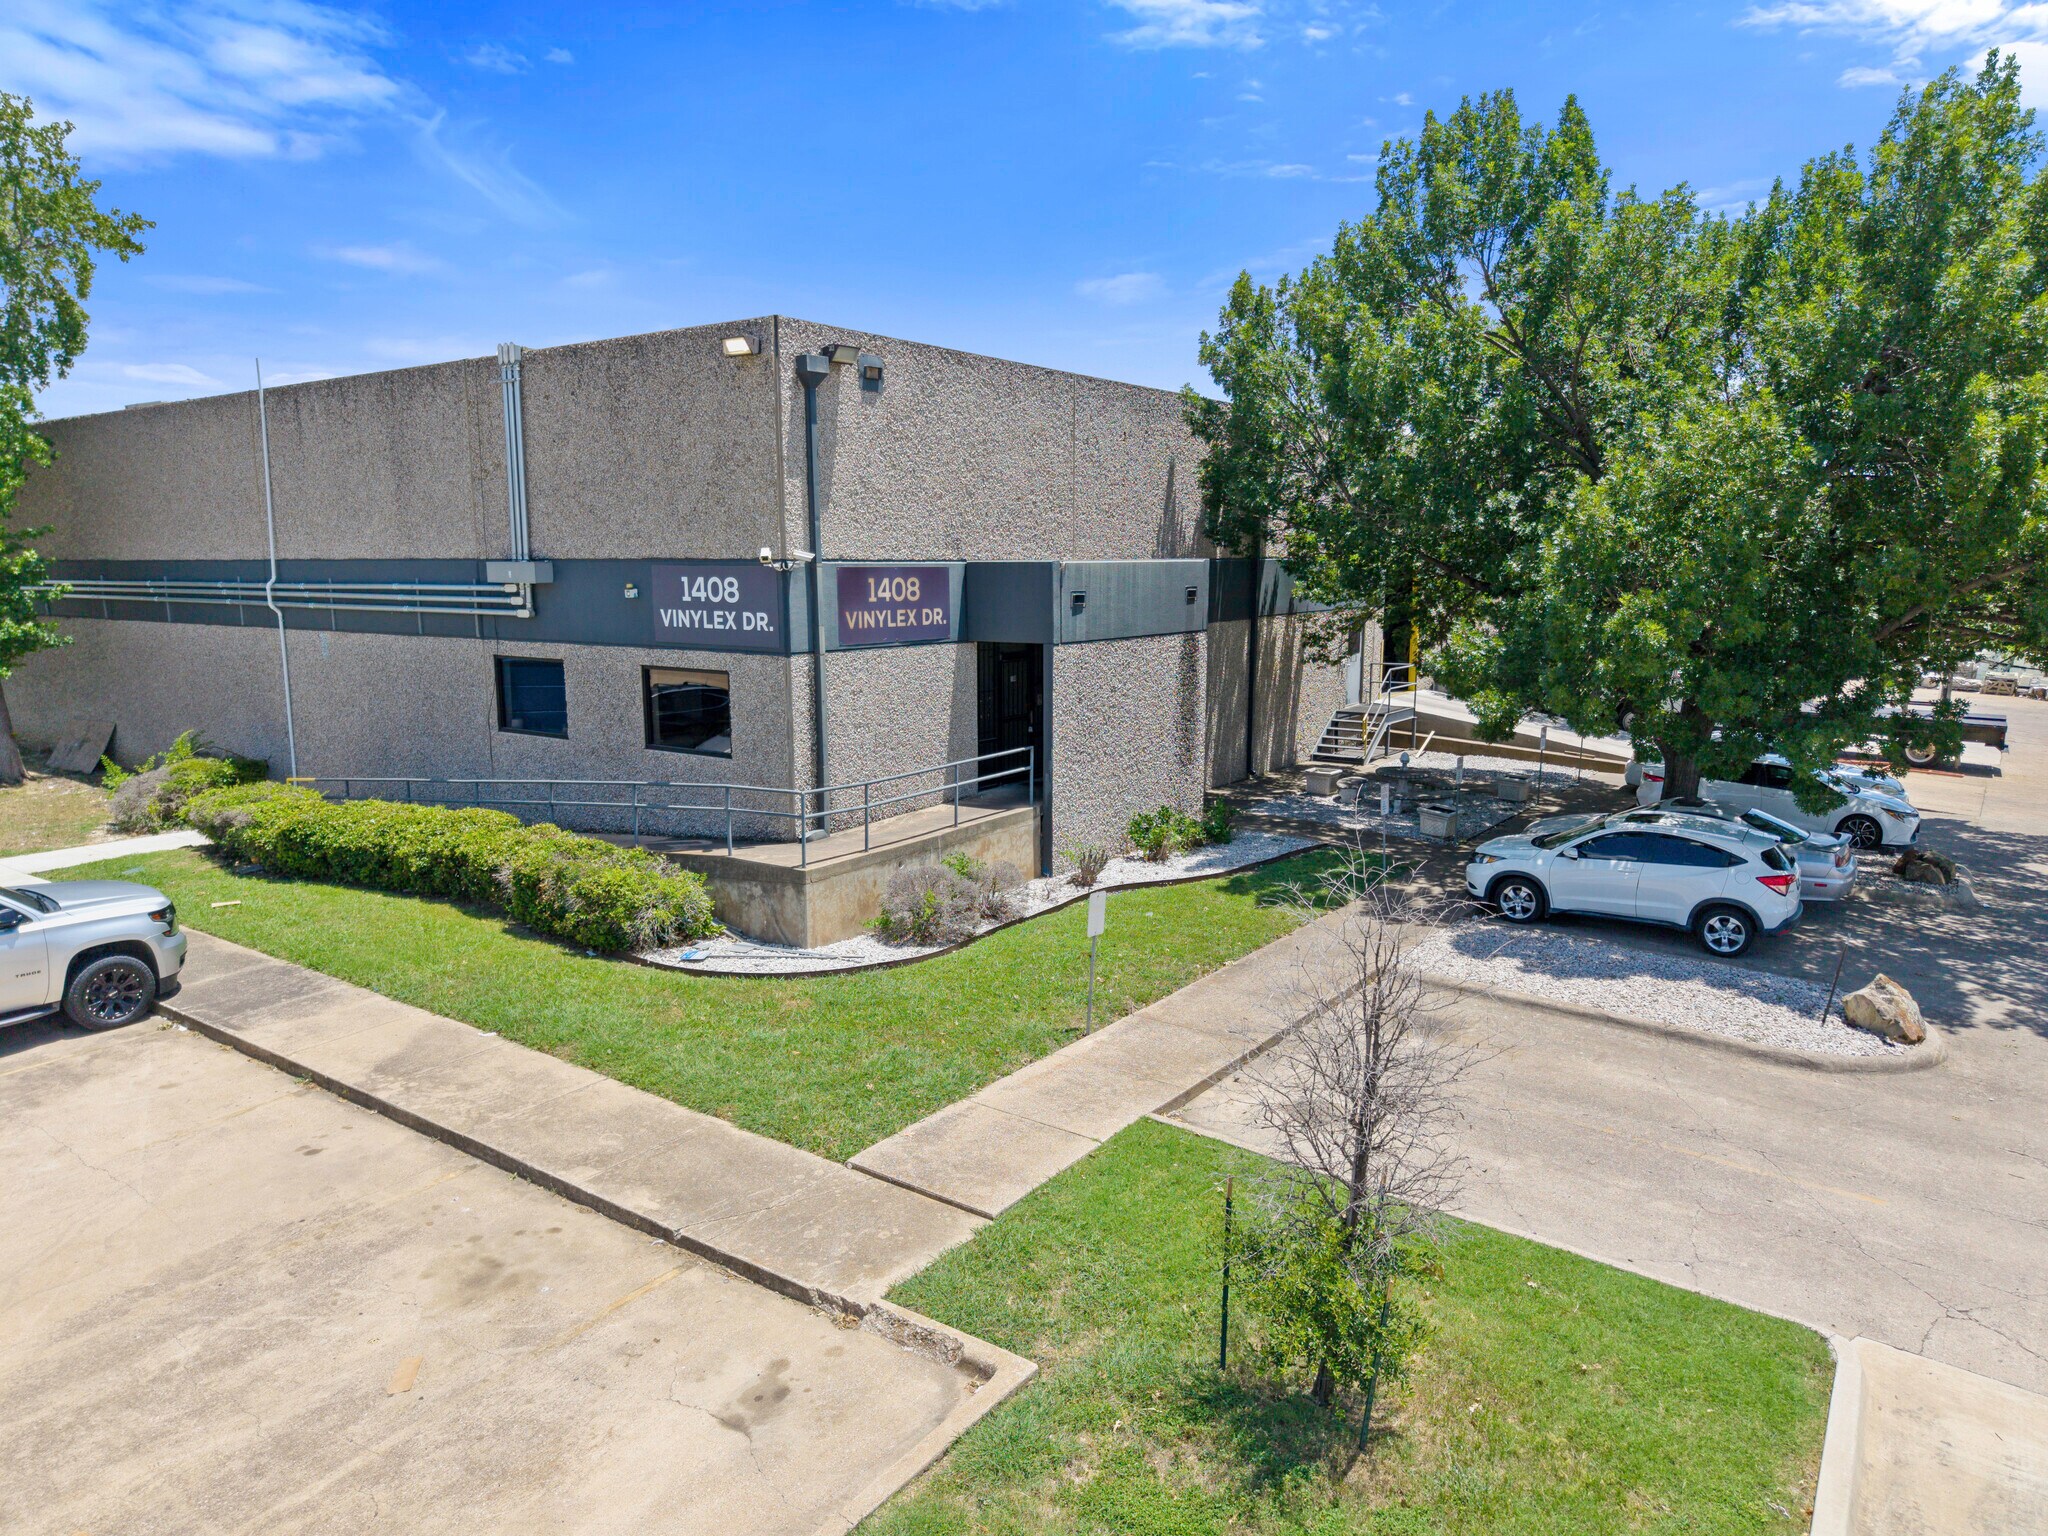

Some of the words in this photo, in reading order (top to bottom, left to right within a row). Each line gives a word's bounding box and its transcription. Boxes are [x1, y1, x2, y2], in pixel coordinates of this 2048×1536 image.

[681, 576, 740, 604] 1408
[868, 577, 920, 602] 1408
[660, 608, 737, 630] VINYLEX
[742, 611, 774, 632] DR.
[845, 609, 917, 630] VINYLEX
[922, 607, 947, 626] DR.
